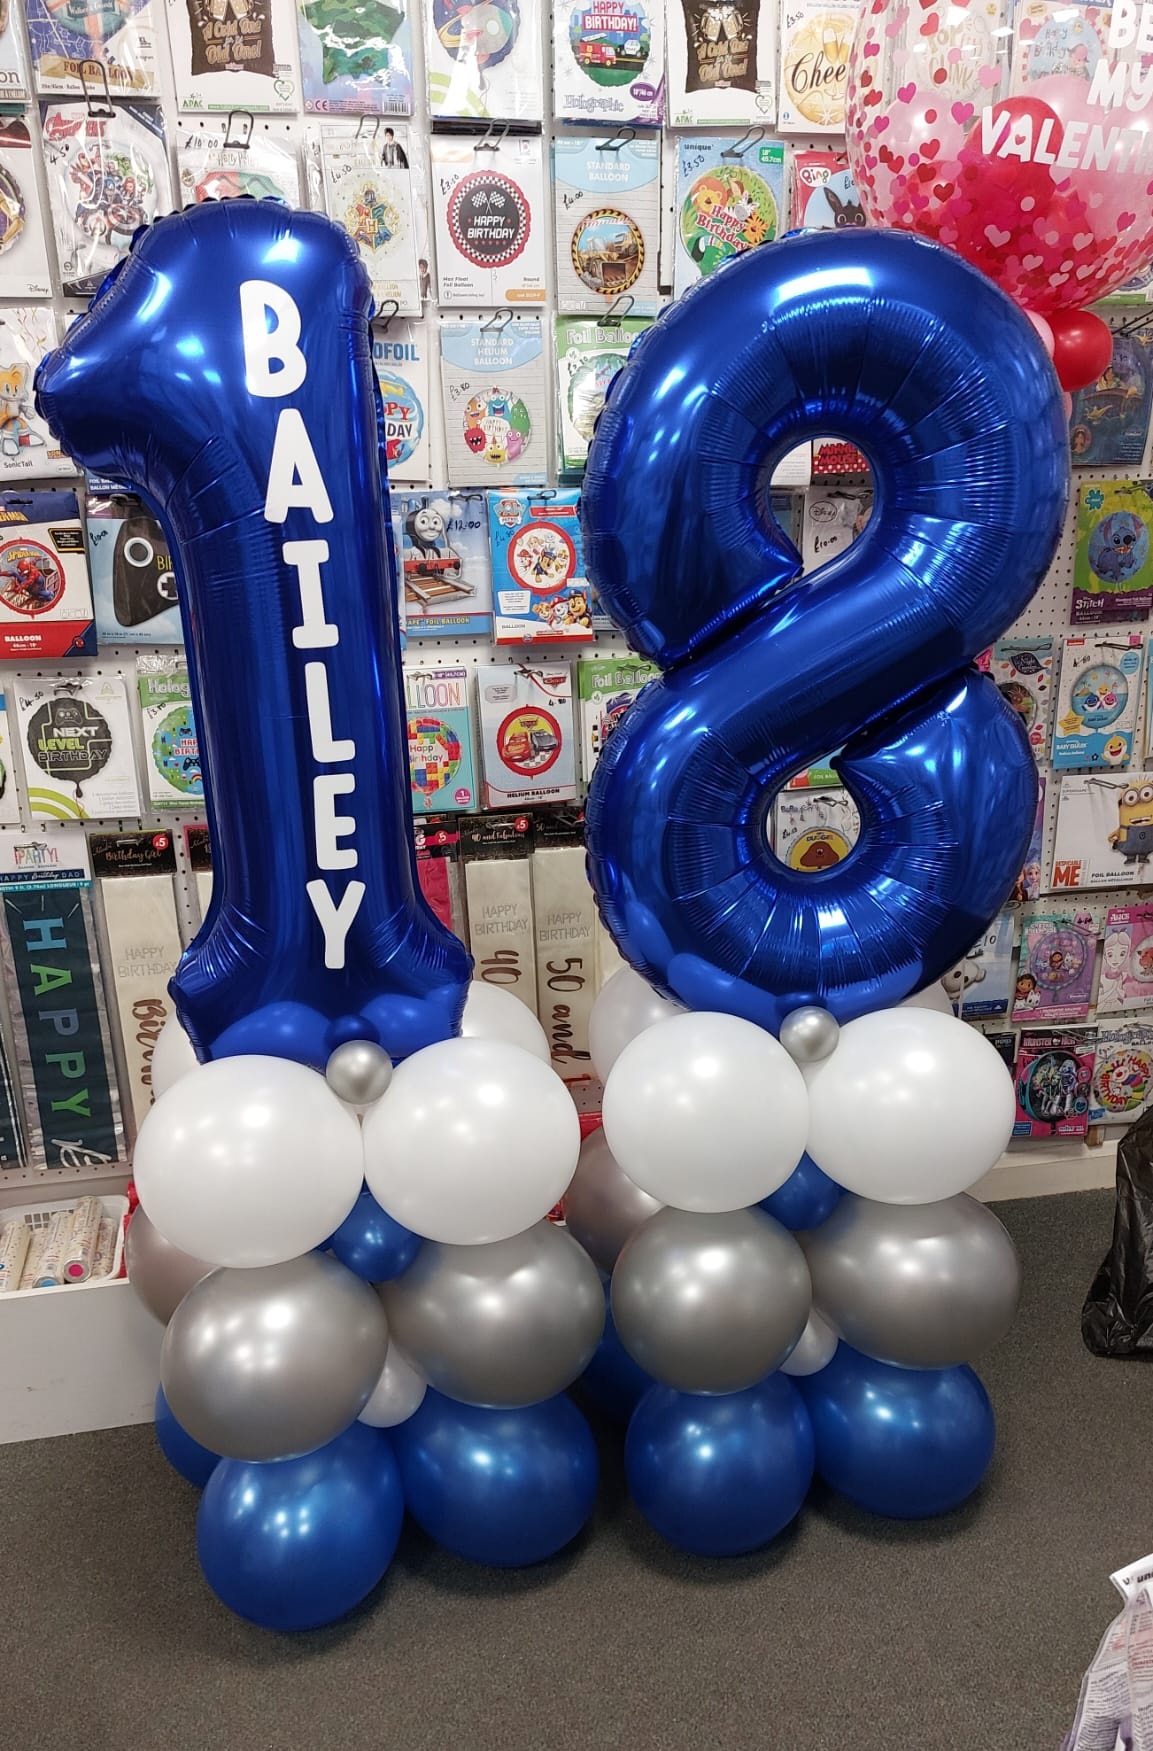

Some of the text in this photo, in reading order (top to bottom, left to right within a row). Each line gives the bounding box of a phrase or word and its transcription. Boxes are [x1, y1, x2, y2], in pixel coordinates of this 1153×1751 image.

[593, 1, 625, 14] HAPPY
[585, 15, 637, 31] BIRTHDAY!
[683, 143, 714, 151] unique
[586, 161, 631, 171] STANDARD
[588, 172, 629, 183] BALLOON
[802, 169, 829, 184] Bing
[473, 215, 505, 227] HAPPY
[711, 204, 746, 233] Happy
[467, 227, 515, 240] BIRTHDAY
[696, 213, 749, 252] Birthday
[471, 337, 514, 346] STANDARD
[566, 328, 592, 344] Foil
[478, 347, 508, 356] HELIUM
[474, 357, 513, 366] BALLOON
[240, 280, 366, 968] BAILEY
[441, 617, 471, 625] BALLOON
[4, 635, 42, 643] BALLOON
[591, 673, 612, 689] Foil
[52, 726, 99, 738] NEXT
[38, 738, 85, 751] LEVEL
[38, 749, 108, 763] BIRTHDAY
[506, 788, 560, 798] HELIUM BALLOON
[1053, 865, 1082, 887] ME
[481, 904, 518, 919] HAPPY
[547, 911, 582, 926] HAPPY
[475, 918, 529, 936] BIRTHDAY
[539, 926, 592, 942] BIRTHDAY
[125, 945, 166, 960] HAPPY
[480, 949, 522, 985] 40
[22, 917, 91, 1117] HAPPY
[546, 957, 592, 1064] 50 and
[1127, 1055, 1151, 1079] HAPPY
[1101, 1073, 1129, 1105] BIRTHDAY
